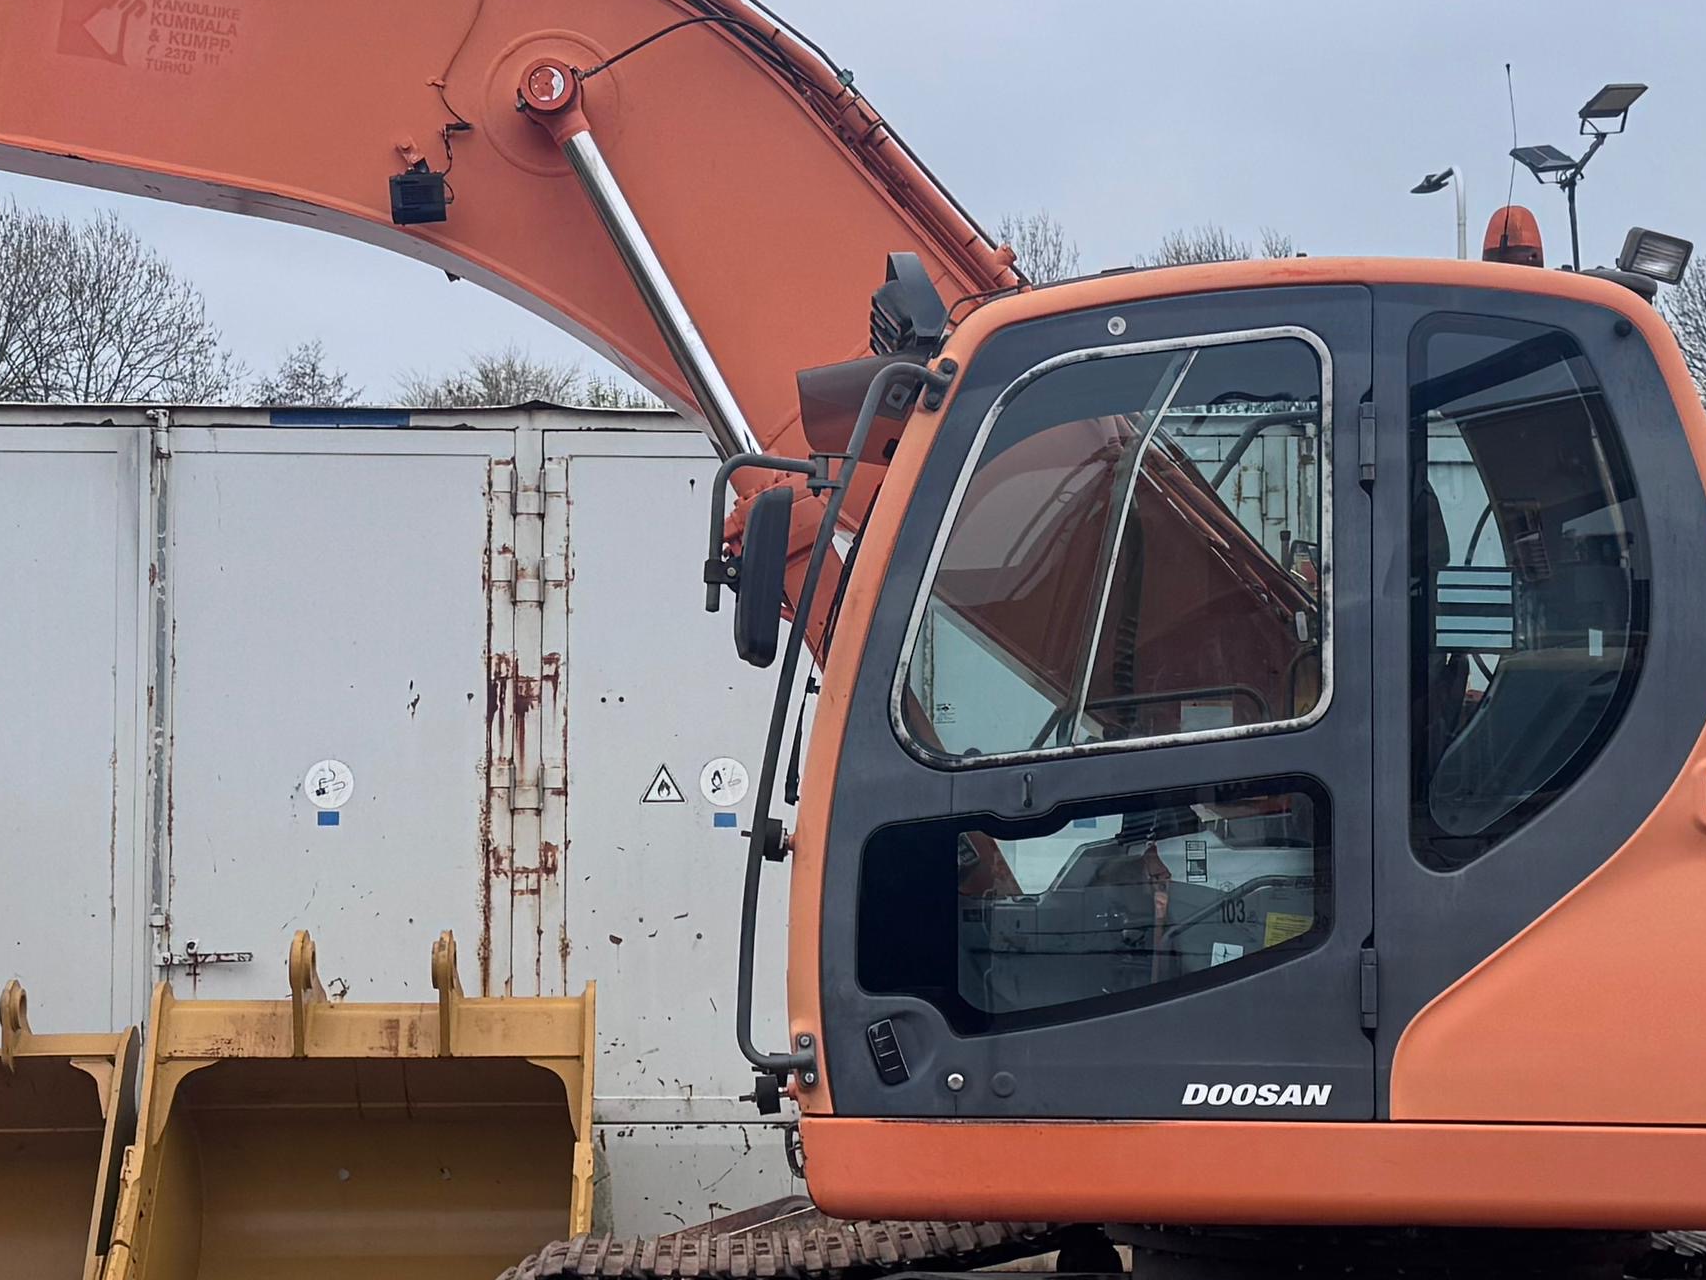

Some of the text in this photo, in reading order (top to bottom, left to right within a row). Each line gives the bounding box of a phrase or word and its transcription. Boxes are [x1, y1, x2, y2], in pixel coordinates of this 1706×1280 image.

[150, 13, 237, 37] KUMMALA
[148, 29, 160, 42] &
[145, 58, 193, 75] TURKU
[1181, 1083, 1332, 1106] DOOSAN
